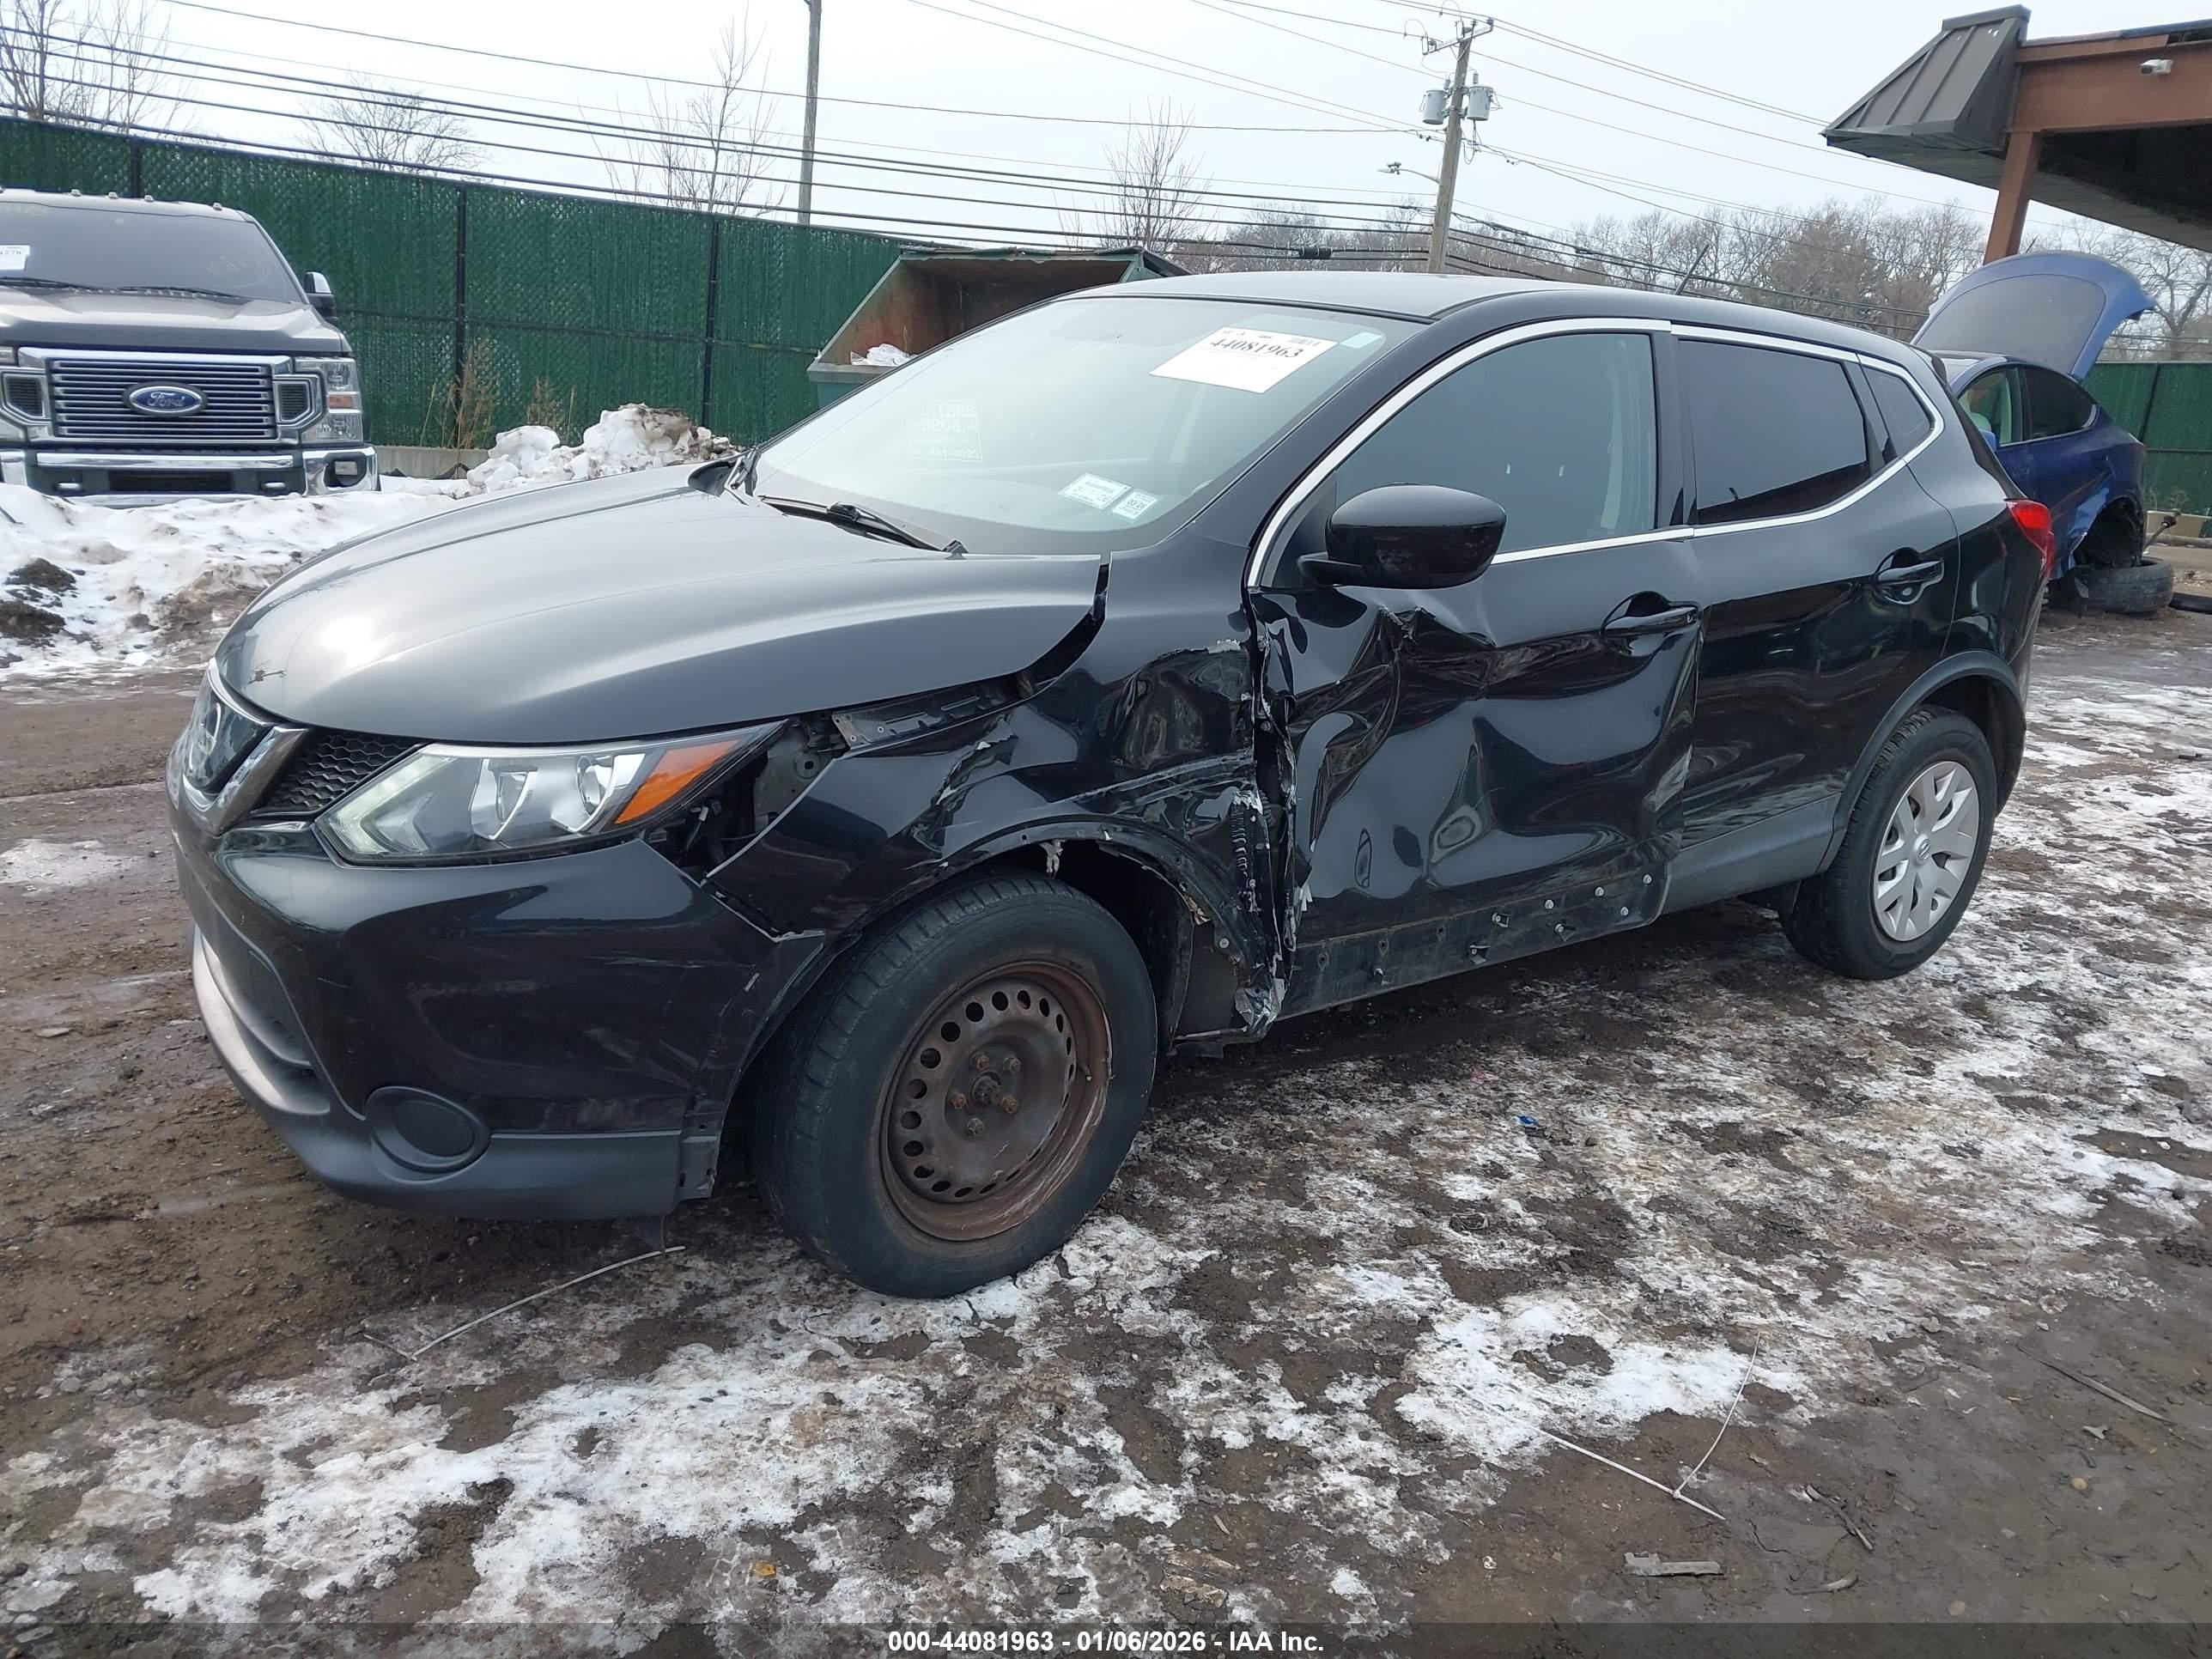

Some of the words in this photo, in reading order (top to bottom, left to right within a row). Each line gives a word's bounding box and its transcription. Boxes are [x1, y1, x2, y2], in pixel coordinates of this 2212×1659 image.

[1210, 337, 1304, 358] 44081963
[147, 392, 185, 407] Ford
[920, 417, 967, 433] BROS.
